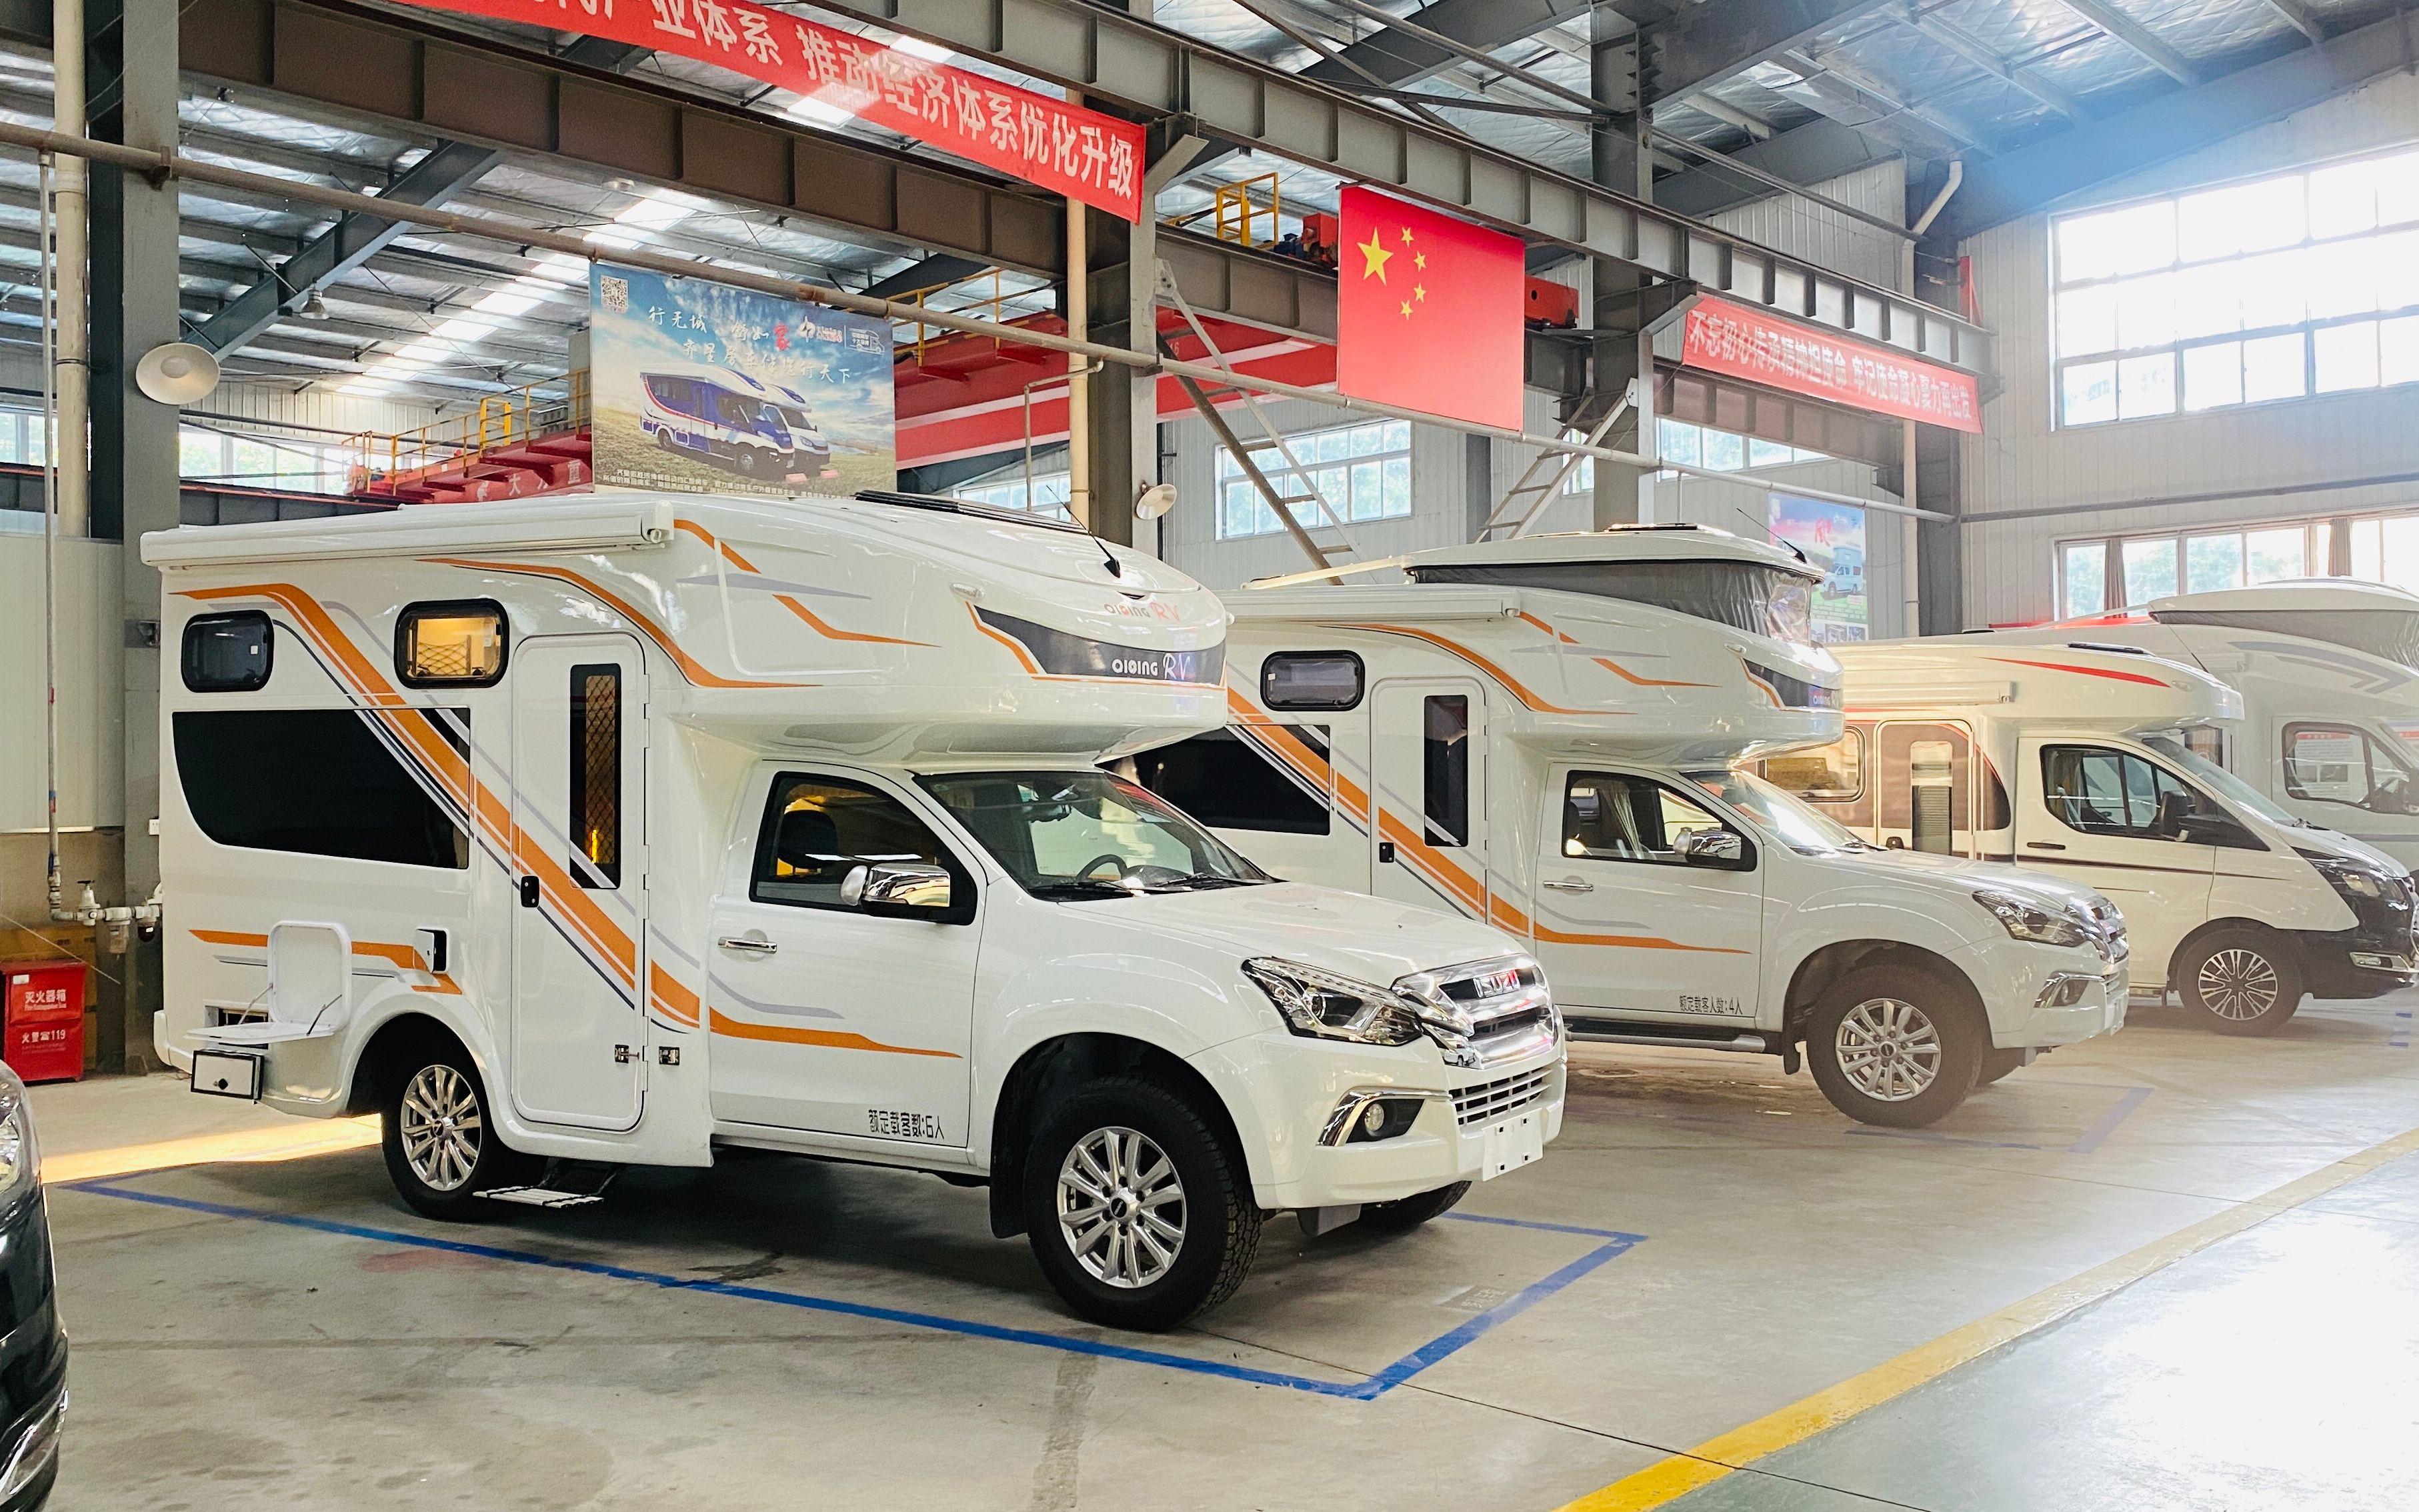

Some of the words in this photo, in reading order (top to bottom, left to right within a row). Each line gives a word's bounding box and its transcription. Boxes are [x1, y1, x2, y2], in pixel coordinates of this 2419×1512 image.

[795, 24, 1133, 201] 推动经济体系优化升级
[1149, 601, 1181, 623] RV
[1162, 653, 1191, 681] RV
[1473, 969, 1520, 998] ISUZU
[25, 989, 66, 1004] 灭火器箱
[1680, 995, 1743, 1015] 额定载客人数:4人
[51, 1029, 66, 1040] 119
[868, 1109, 945, 1140] 额定载客数:6人
